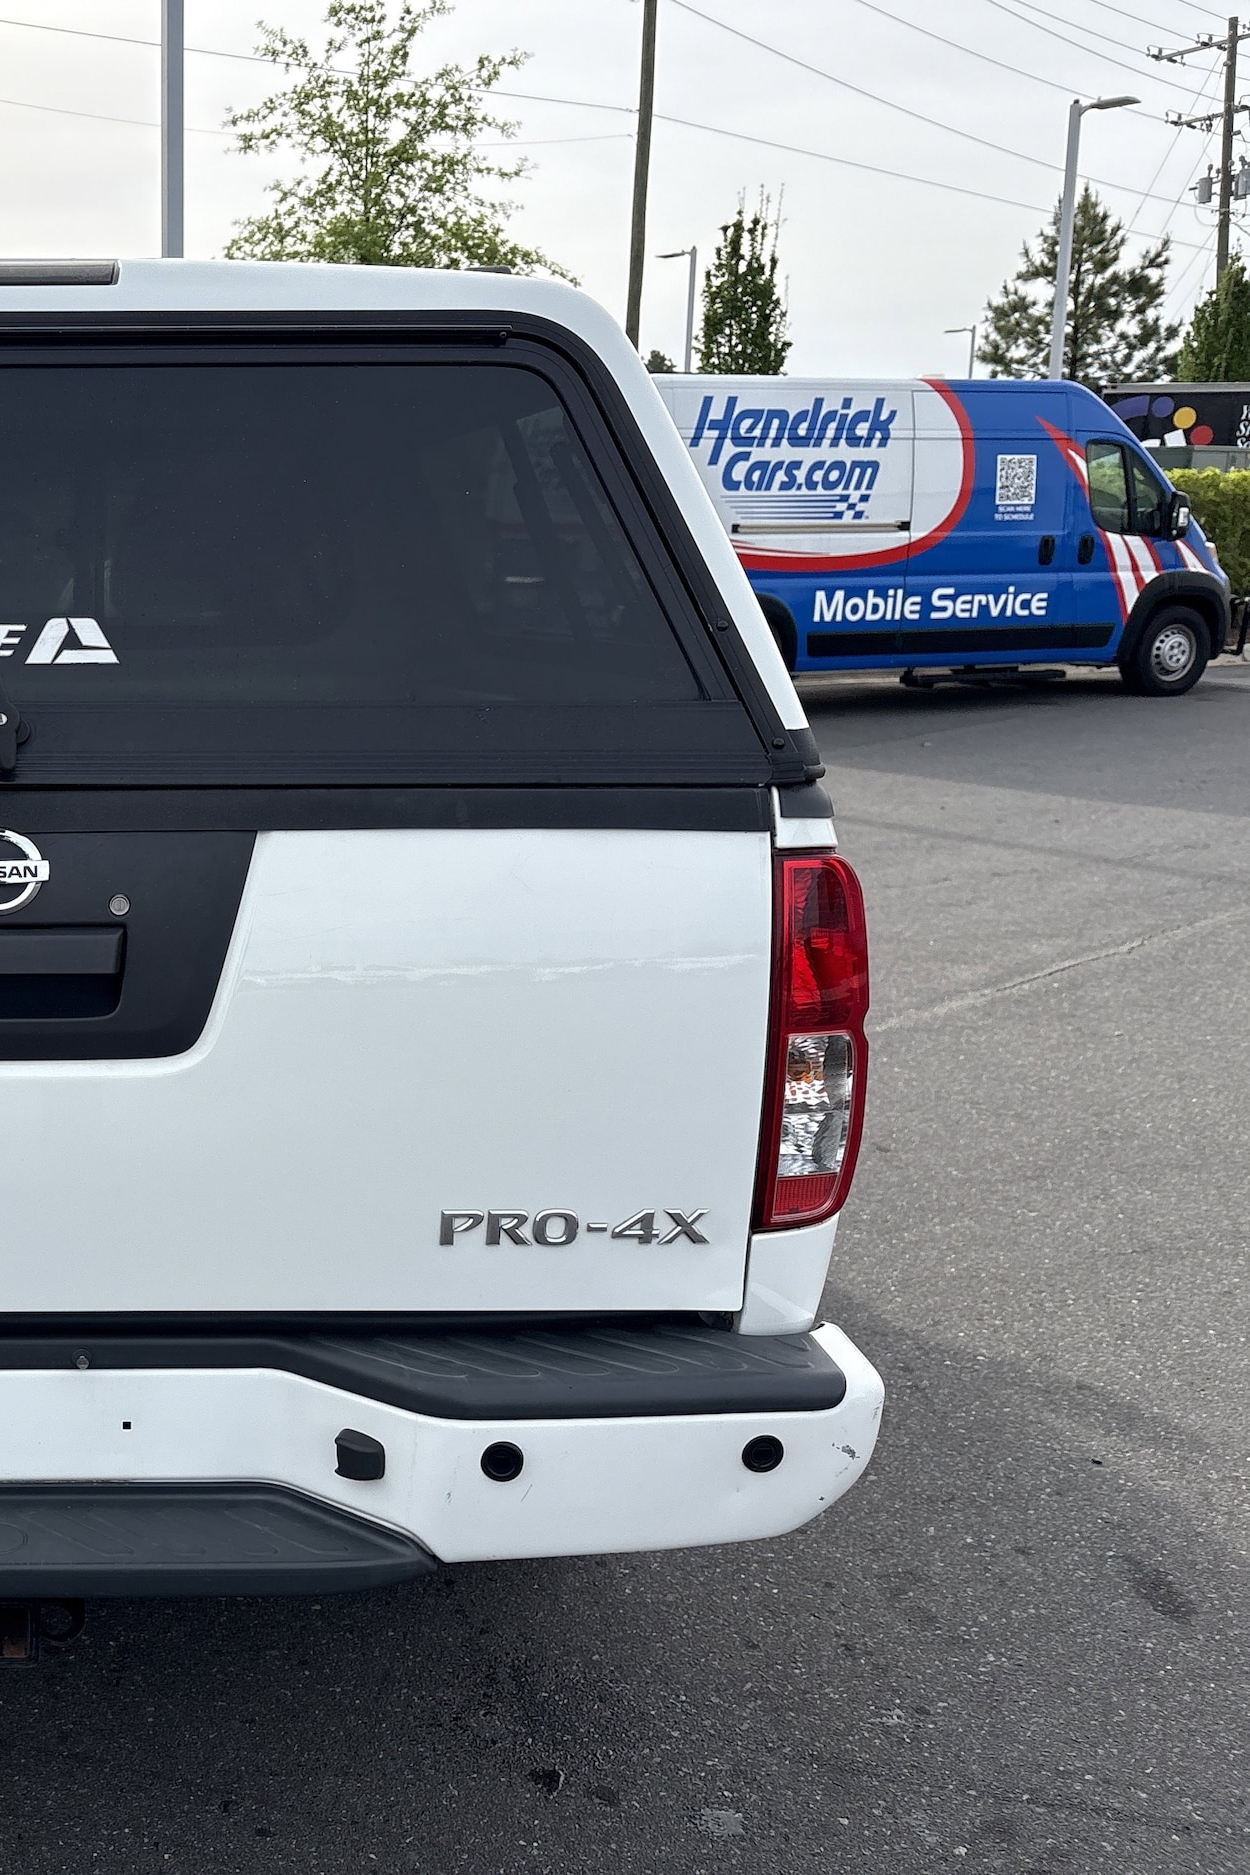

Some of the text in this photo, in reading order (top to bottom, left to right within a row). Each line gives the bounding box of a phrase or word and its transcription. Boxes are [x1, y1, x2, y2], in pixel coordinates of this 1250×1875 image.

[689, 396, 898, 466] Hendrick
[721, 451, 881, 491] Cars.com
[813, 585, 1049, 623] Mobile Service
[439, 1208, 711, 1246] PRO-4X
